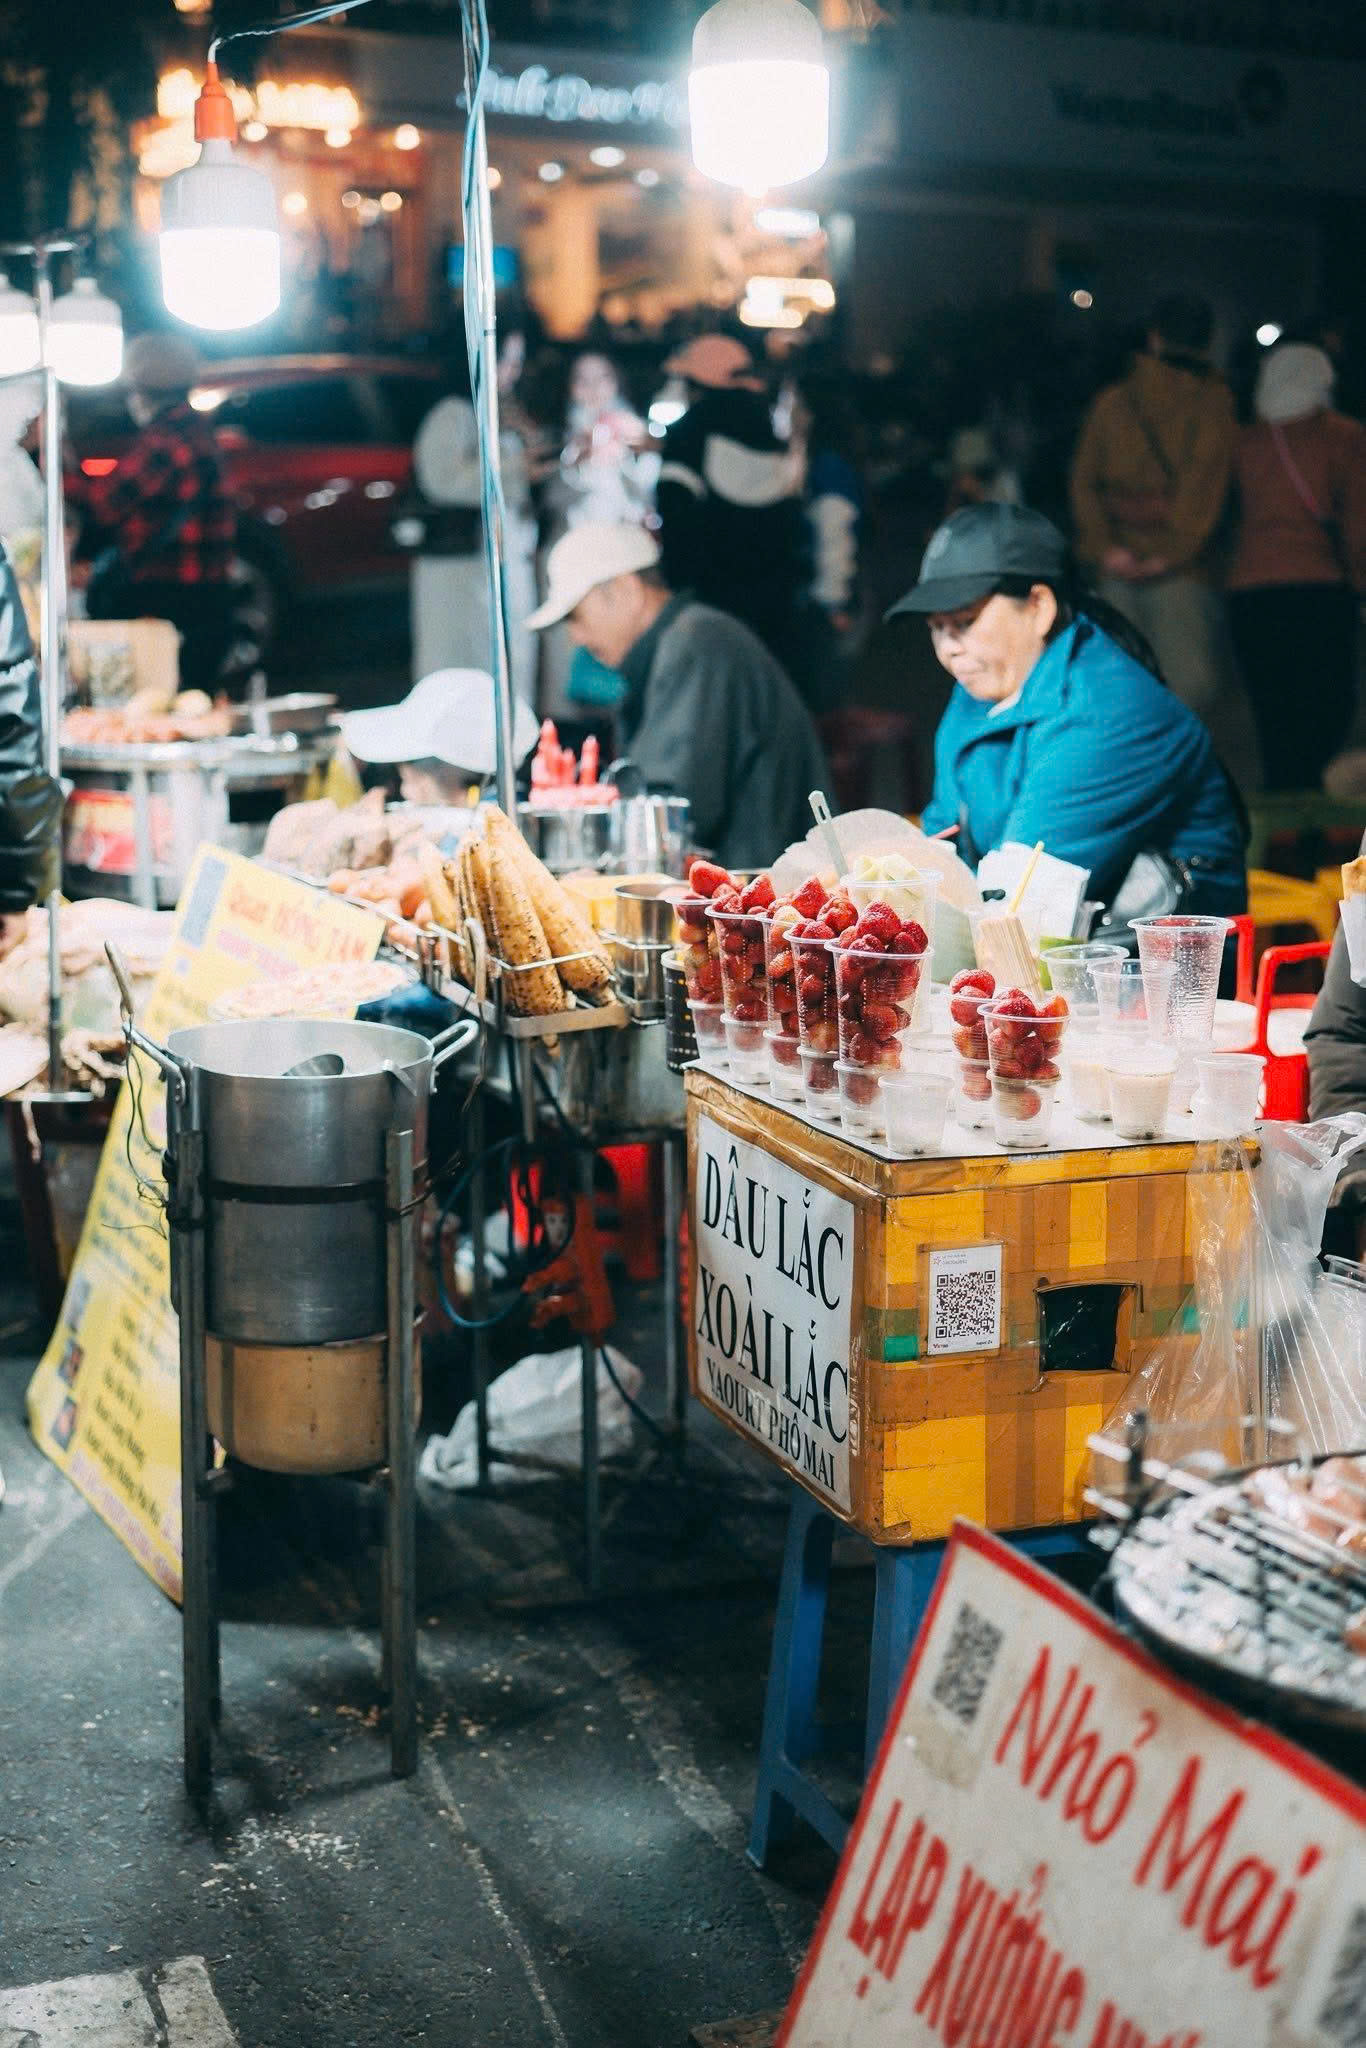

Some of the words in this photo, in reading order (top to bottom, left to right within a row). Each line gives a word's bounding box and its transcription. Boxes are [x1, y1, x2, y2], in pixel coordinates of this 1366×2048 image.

[703, 1145, 768, 1259] DÂU
[776, 1188, 845, 1311] LẮC
[698, 1264, 775, 1390] XOÀI
[782, 1319, 849, 1444] LẮC
[706, 1357, 766, 1432] YAOURT
[768, 1403, 801, 1461] PHÔ
[804, 1434, 835, 1492] MAI
[846, 1799, 949, 1999] LẠP
[994, 1644, 1161, 1846] Nhỏ
[1134, 1754, 1325, 1991] Mai
